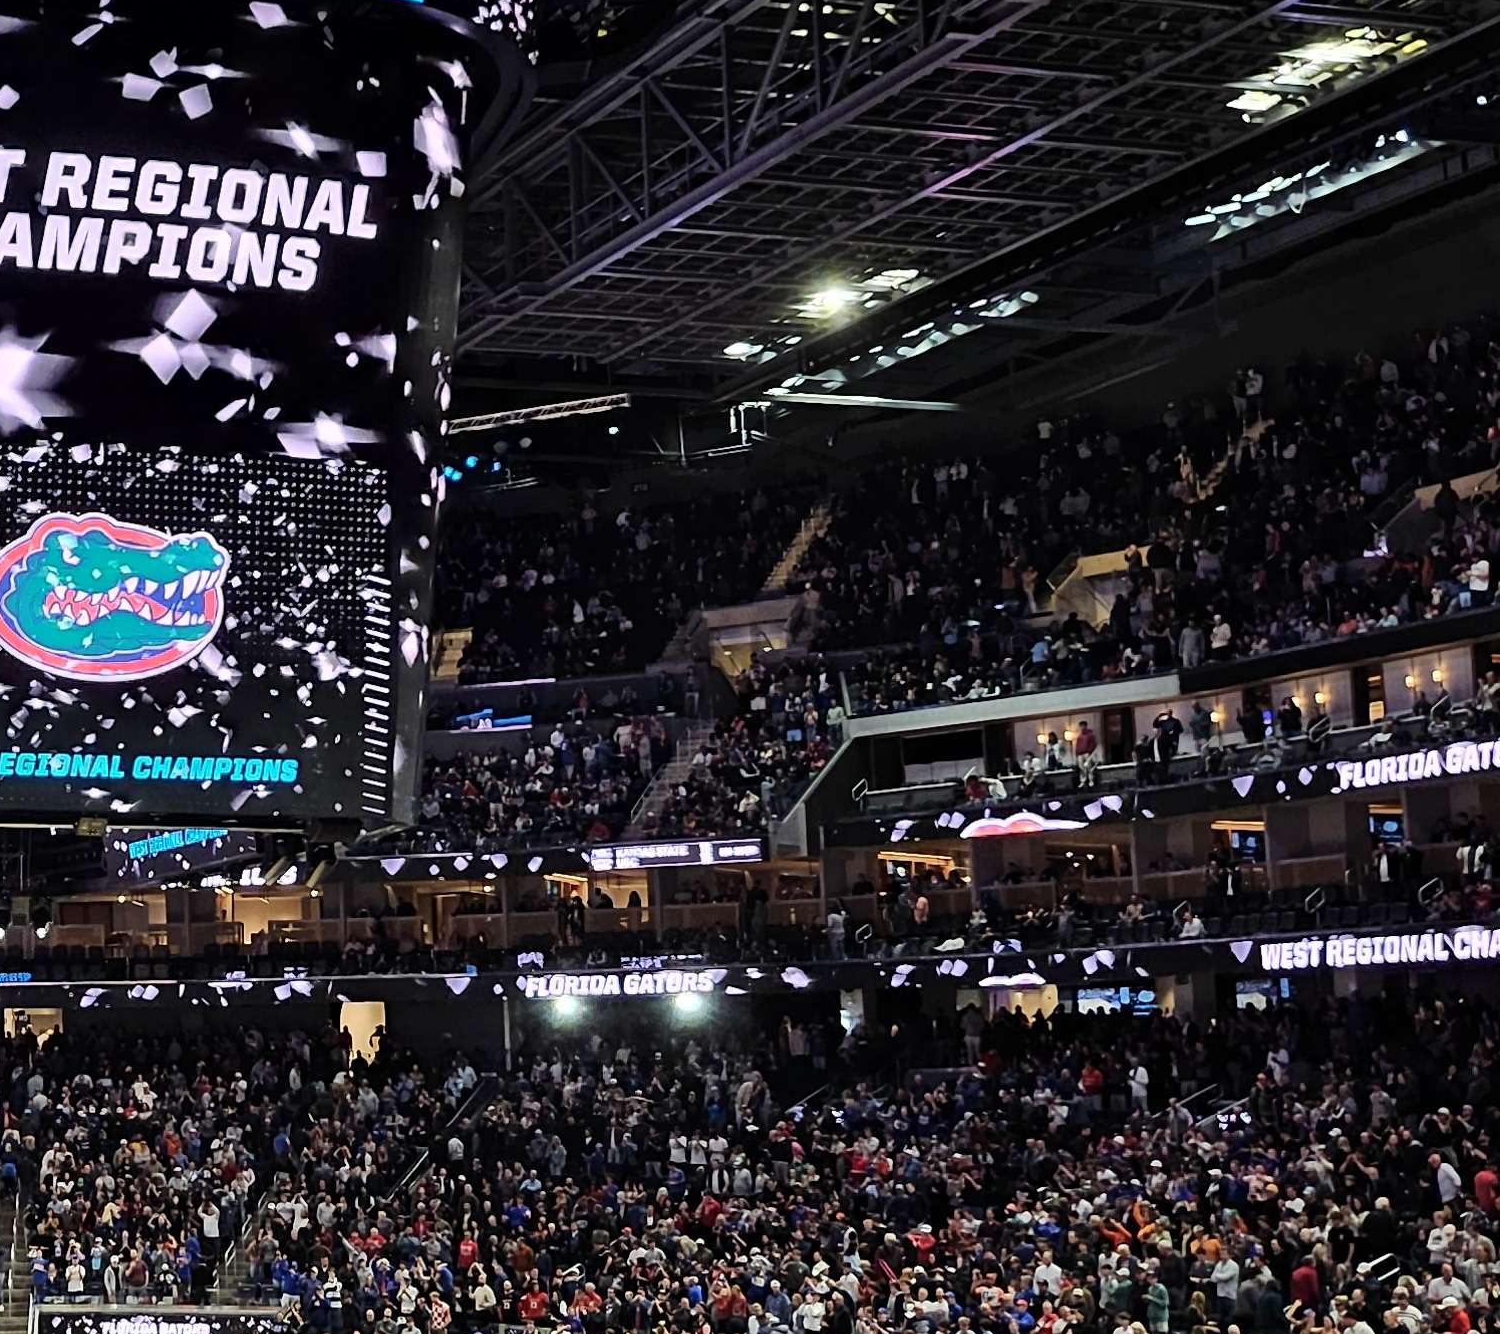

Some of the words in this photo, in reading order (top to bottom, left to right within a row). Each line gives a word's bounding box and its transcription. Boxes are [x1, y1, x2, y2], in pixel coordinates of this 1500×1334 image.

[41, 152, 378, 239] REGIONAL
[132, 755, 298, 782] CHAMPIONS
[1339, 750, 1441, 790] FLORIDA
[1261, 941, 1323, 971] WEST
[1326, 933, 1449, 968] REGIONAL
[525, 975, 621, 998] FLORIDA
[623, 973, 714, 995] GATORS
